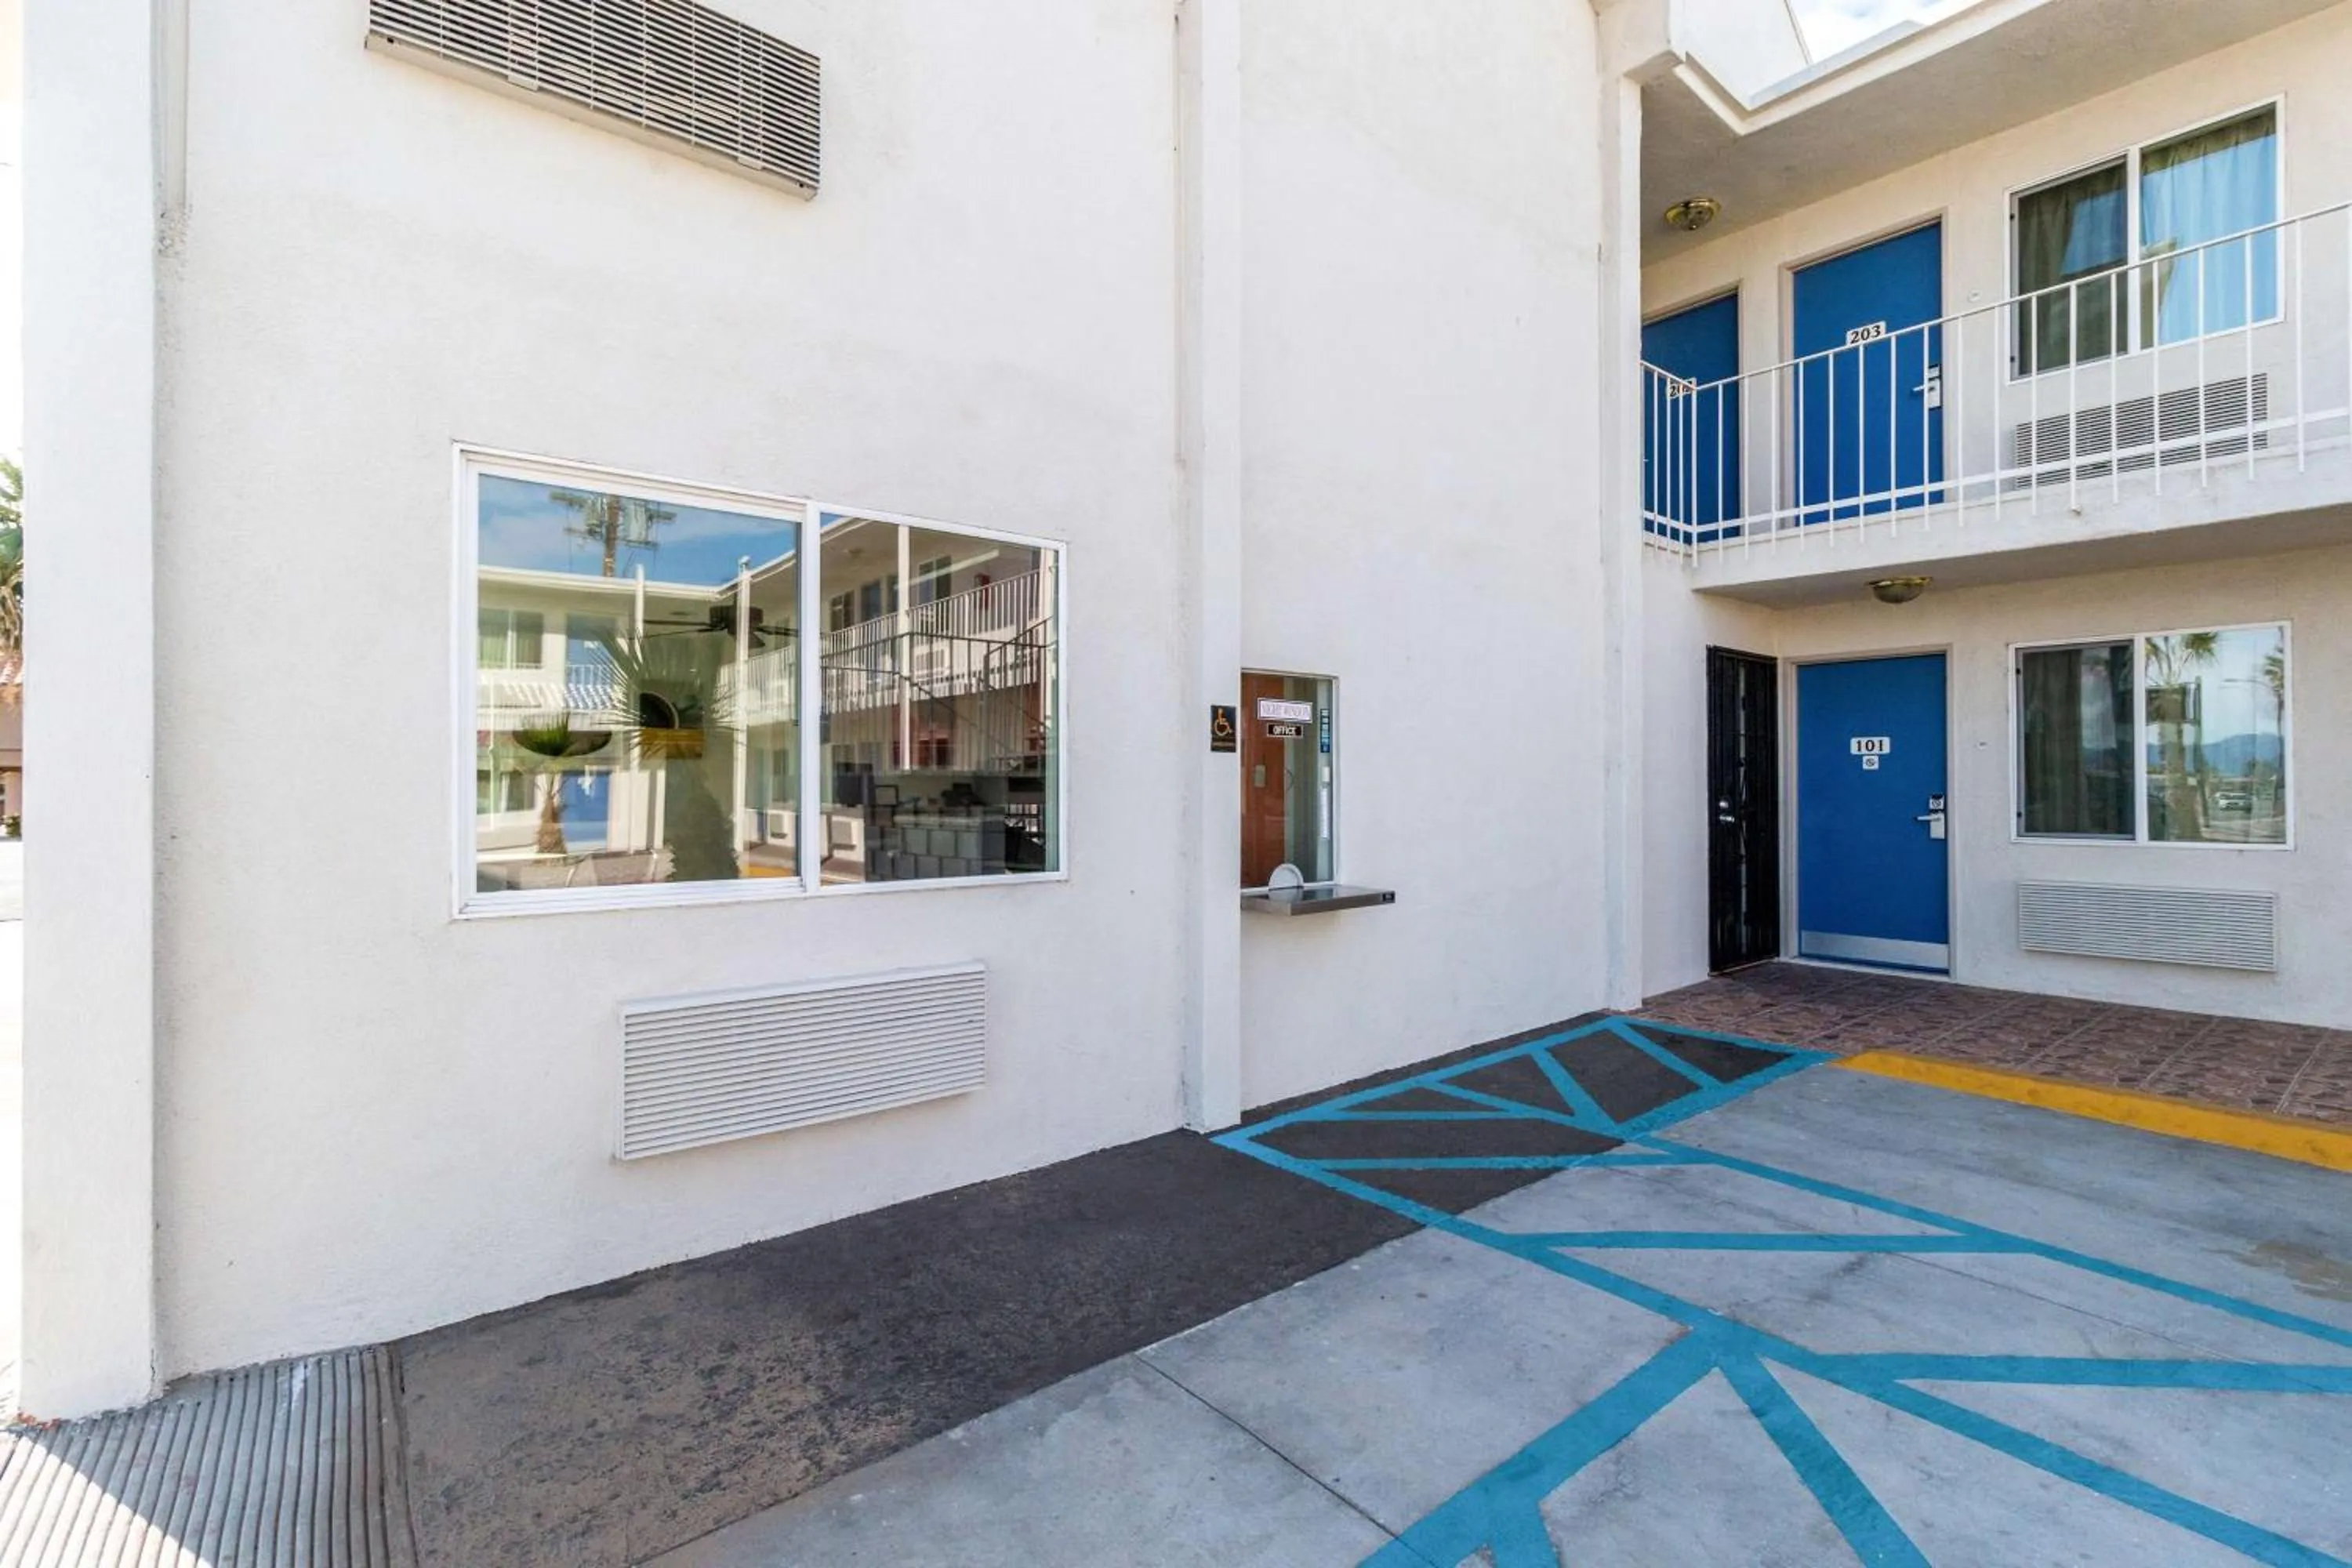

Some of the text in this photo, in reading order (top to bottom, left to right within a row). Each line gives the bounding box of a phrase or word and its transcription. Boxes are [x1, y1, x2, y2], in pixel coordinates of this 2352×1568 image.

[1850, 325, 1881, 344] 203
[1272, 725, 1297, 735] OFFICE
[1857, 739, 1884, 753] 101
